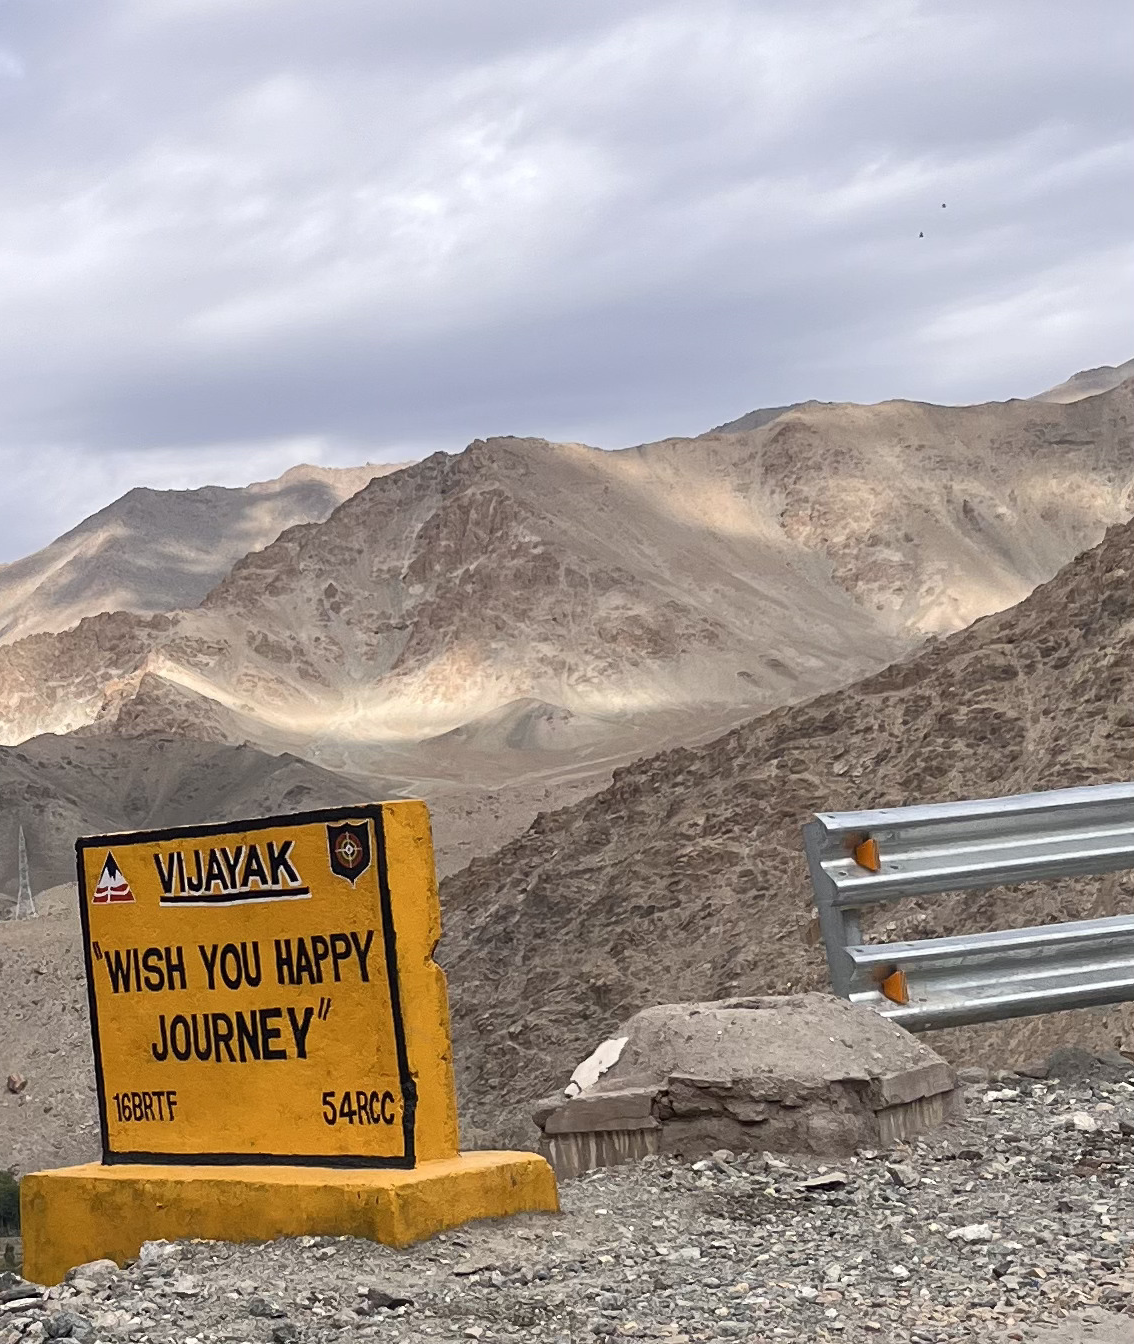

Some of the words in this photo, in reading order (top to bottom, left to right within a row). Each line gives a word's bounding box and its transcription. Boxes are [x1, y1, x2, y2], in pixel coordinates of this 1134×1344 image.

[153, 840, 302, 895] VIJAYAK
[198, 940, 262, 991] YOU
[274, 929, 375, 986] HAPPY
[112, 1090, 178, 1122] 16BRTF
[322, 1090, 396, 1126] 54RCC
